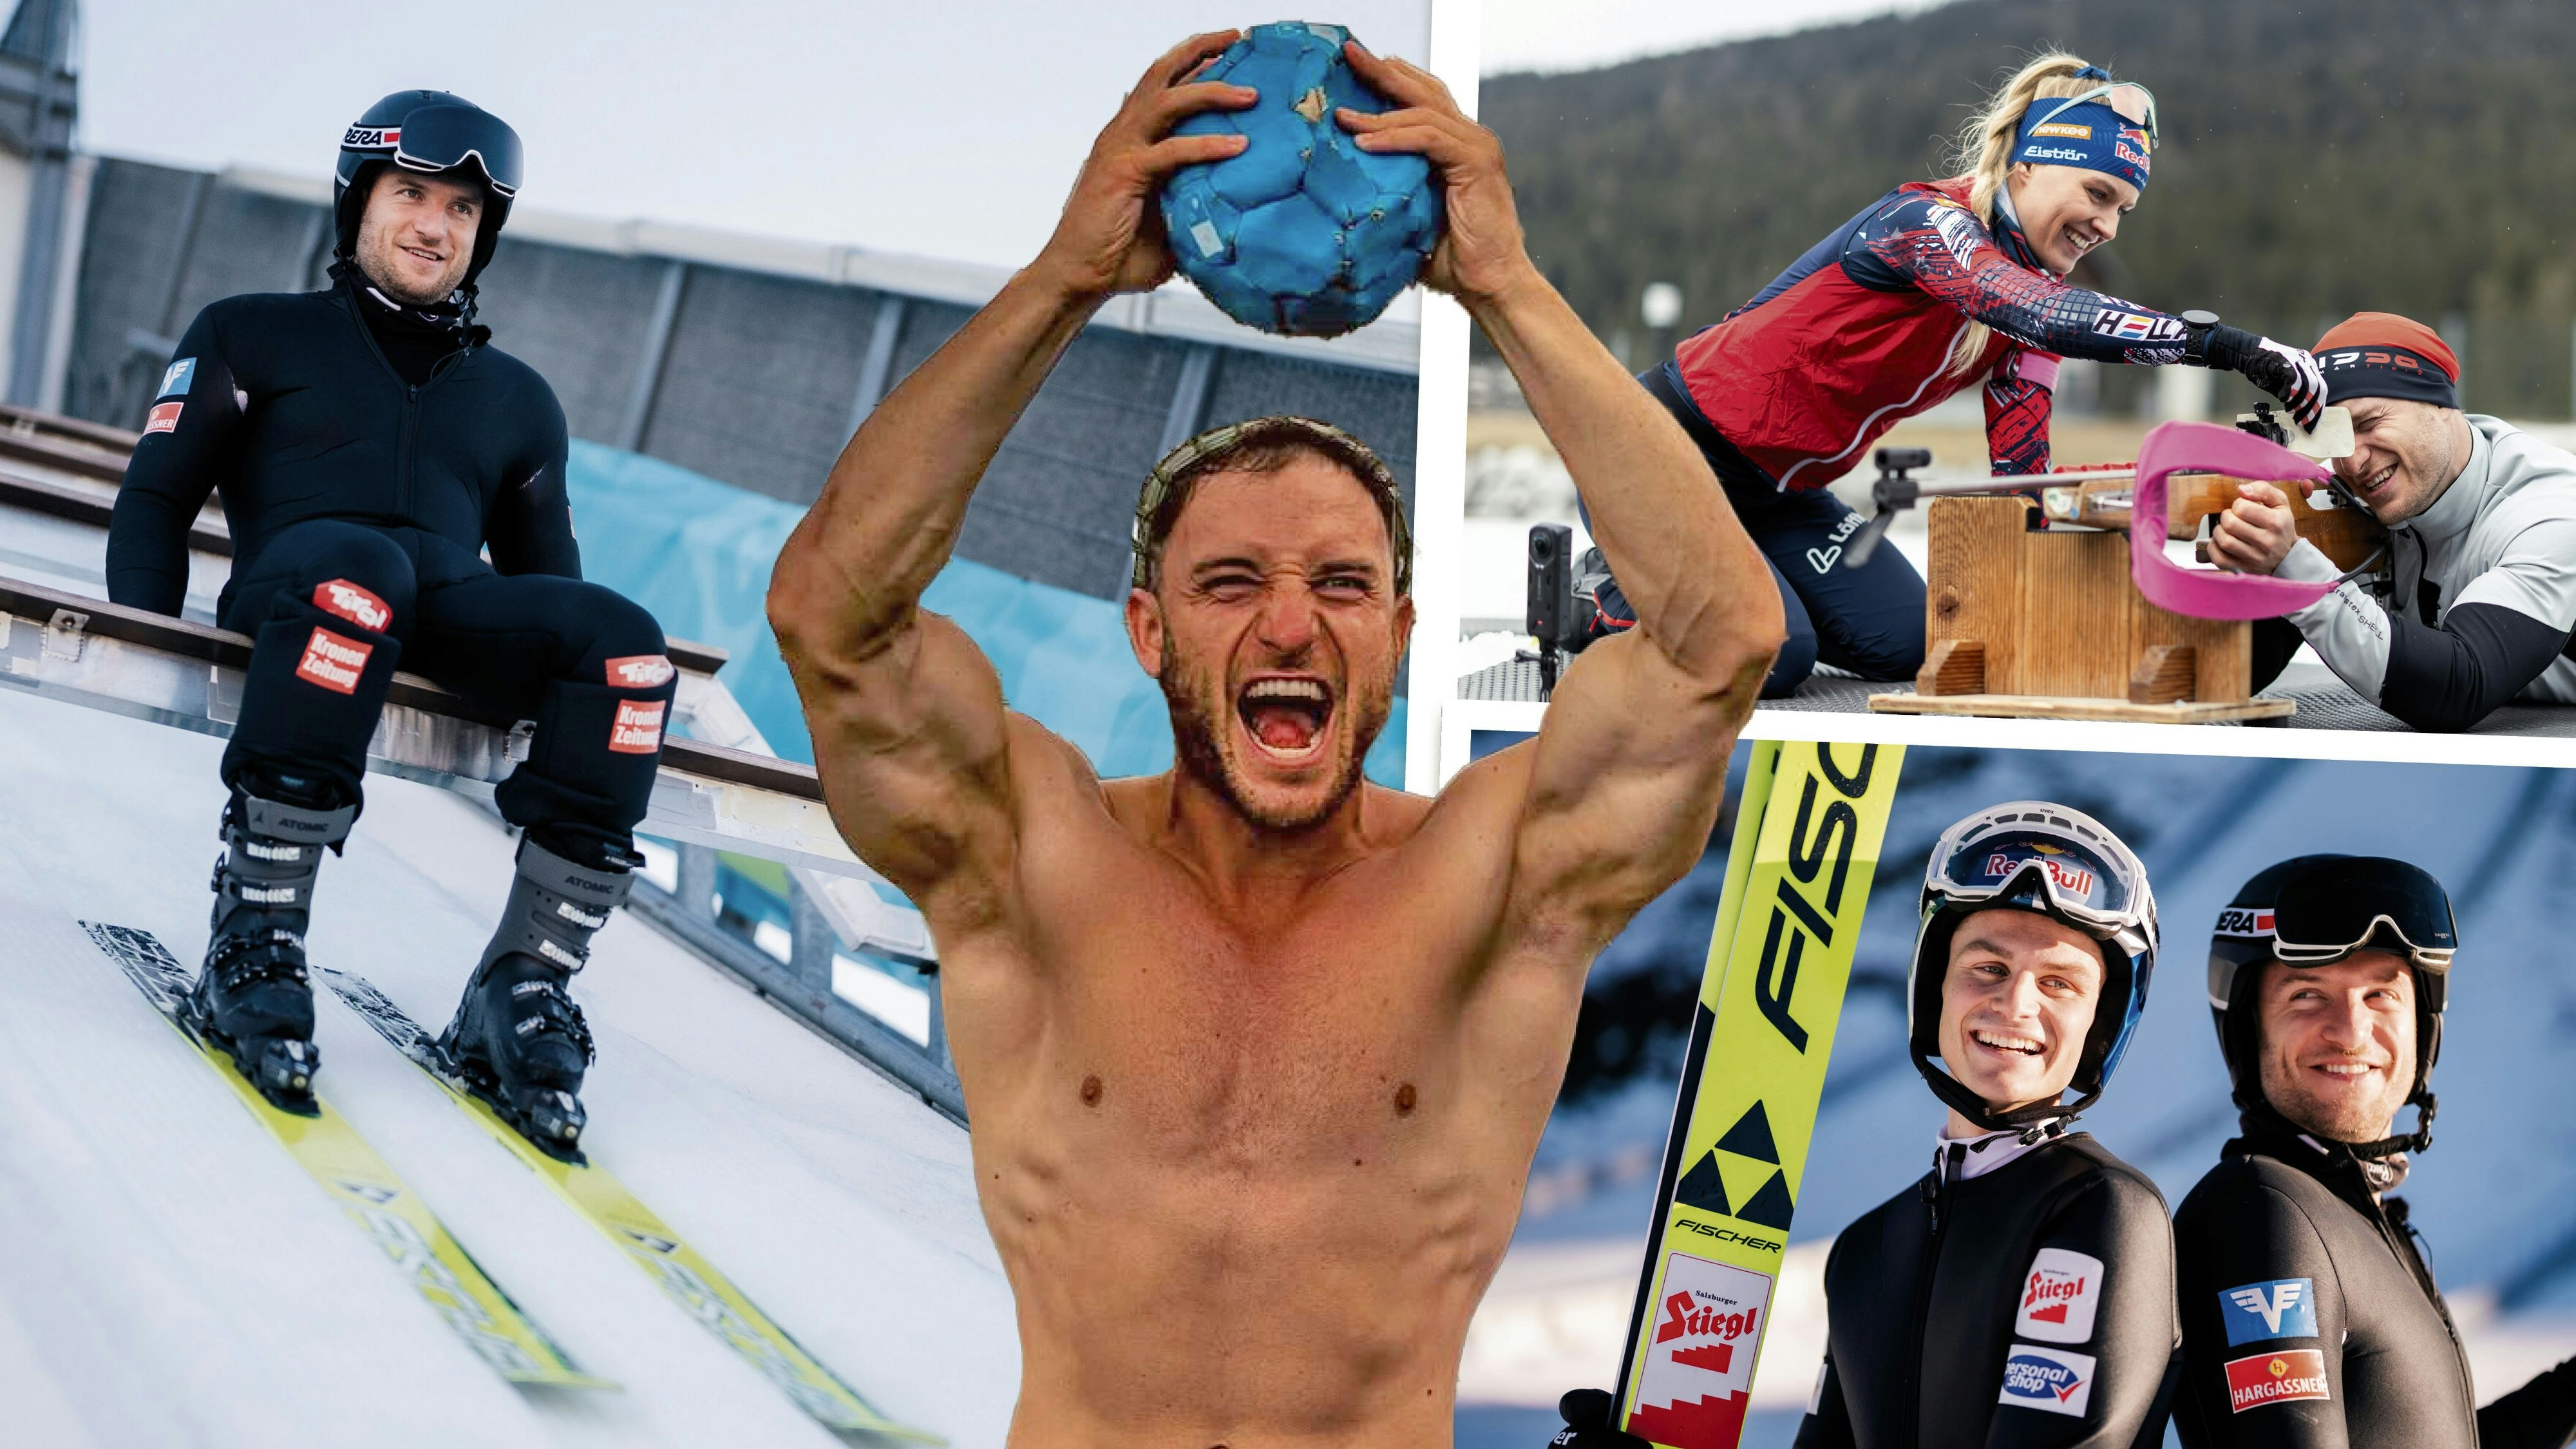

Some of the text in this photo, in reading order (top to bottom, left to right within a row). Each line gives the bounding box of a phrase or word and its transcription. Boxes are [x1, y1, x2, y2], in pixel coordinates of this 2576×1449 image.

[2024, 146, 2088, 161] Eisbär
[2114, 140, 2146, 170] Red
[328, 583, 388, 629] Tirol
[310, 632, 366, 667] Kronen
[303, 652, 359, 688] Zeitung
[614, 725, 661, 748] Zeitung
[278, 818, 329, 832] ATOMIC
[565, 876, 614, 894] ATOMIC
[1674, 1218, 1782, 1254] FISCHER
[1695, 1289, 1738, 1307] Salzburger
[2023, 1271, 2085, 1309] Stiegl
[1656, 1290, 1757, 1344] Stiegl
[2007, 1372, 2045, 1394] shop
[2233, 1377, 2327, 1405] HARGASSNER
